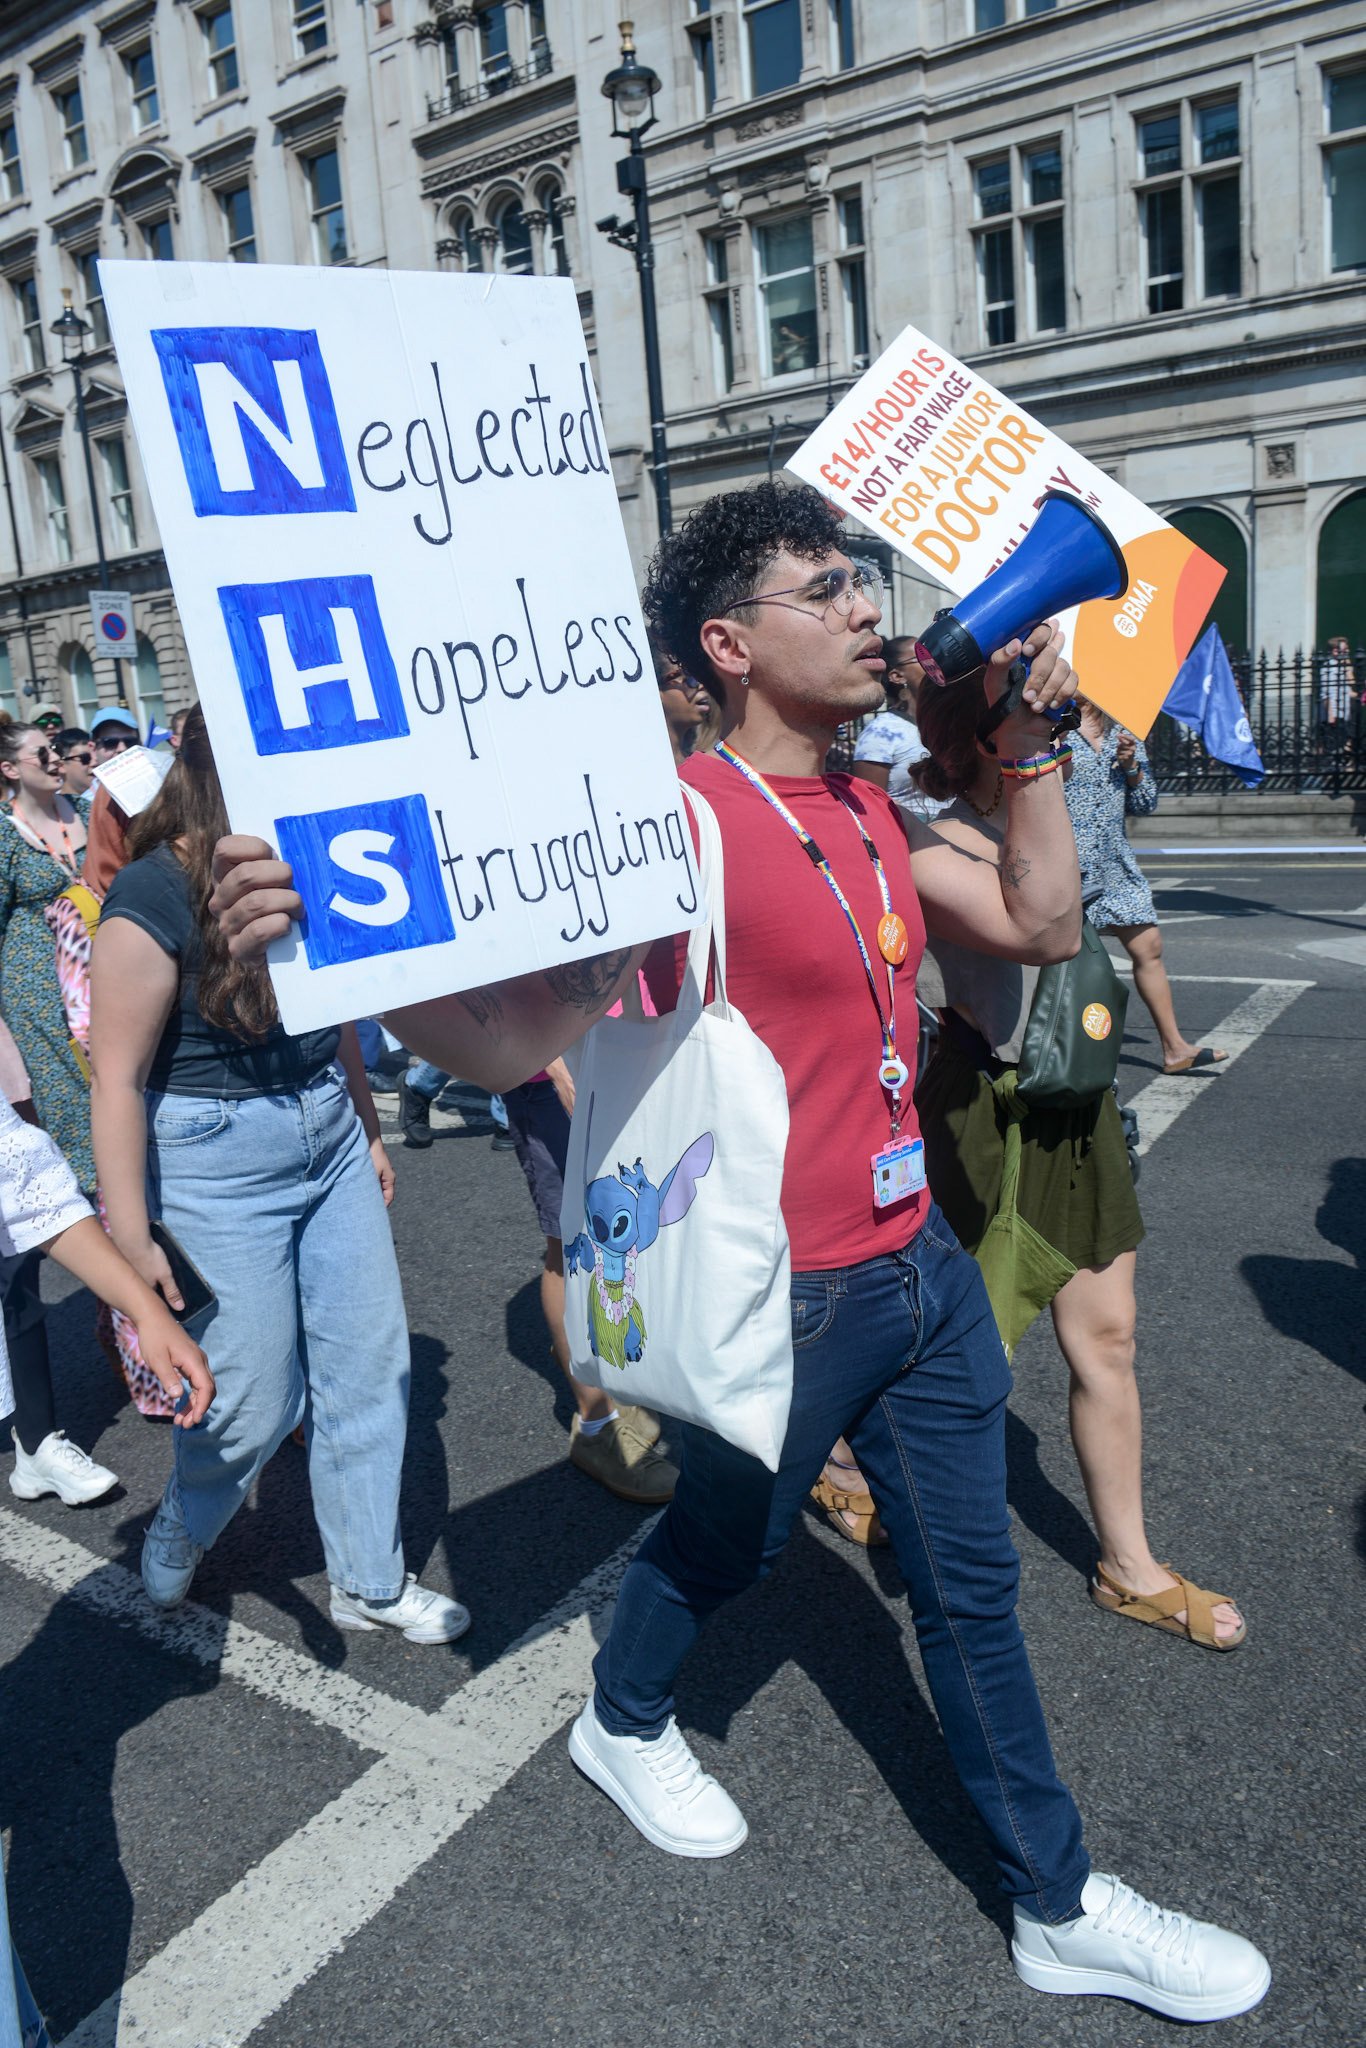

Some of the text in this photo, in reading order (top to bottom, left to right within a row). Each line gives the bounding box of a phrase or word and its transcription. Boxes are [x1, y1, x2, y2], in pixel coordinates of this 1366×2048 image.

[193, 360, 609, 545] Neglected
[820, 348, 945, 490] £14/HOUR IS
[851, 370, 972, 513] NOT A FAIR WAGE
[880, 390, 1001, 537] FOR A JUNIOR
[912, 415, 1045, 574] DOCTOR
[98, 602, 123, 610] ZONE
[1122, 579, 1158, 622] BMA
[258, 577, 644, 760] Hopeless
[733, 755, 753, 774] BMA
[328, 773, 698, 942] Struggling
[829, 876, 844, 900] BMA
[857, 933, 868, 959] BMA
[889, 927, 898, 948] NOW
[1085, 1006, 1098, 1031] PAY
